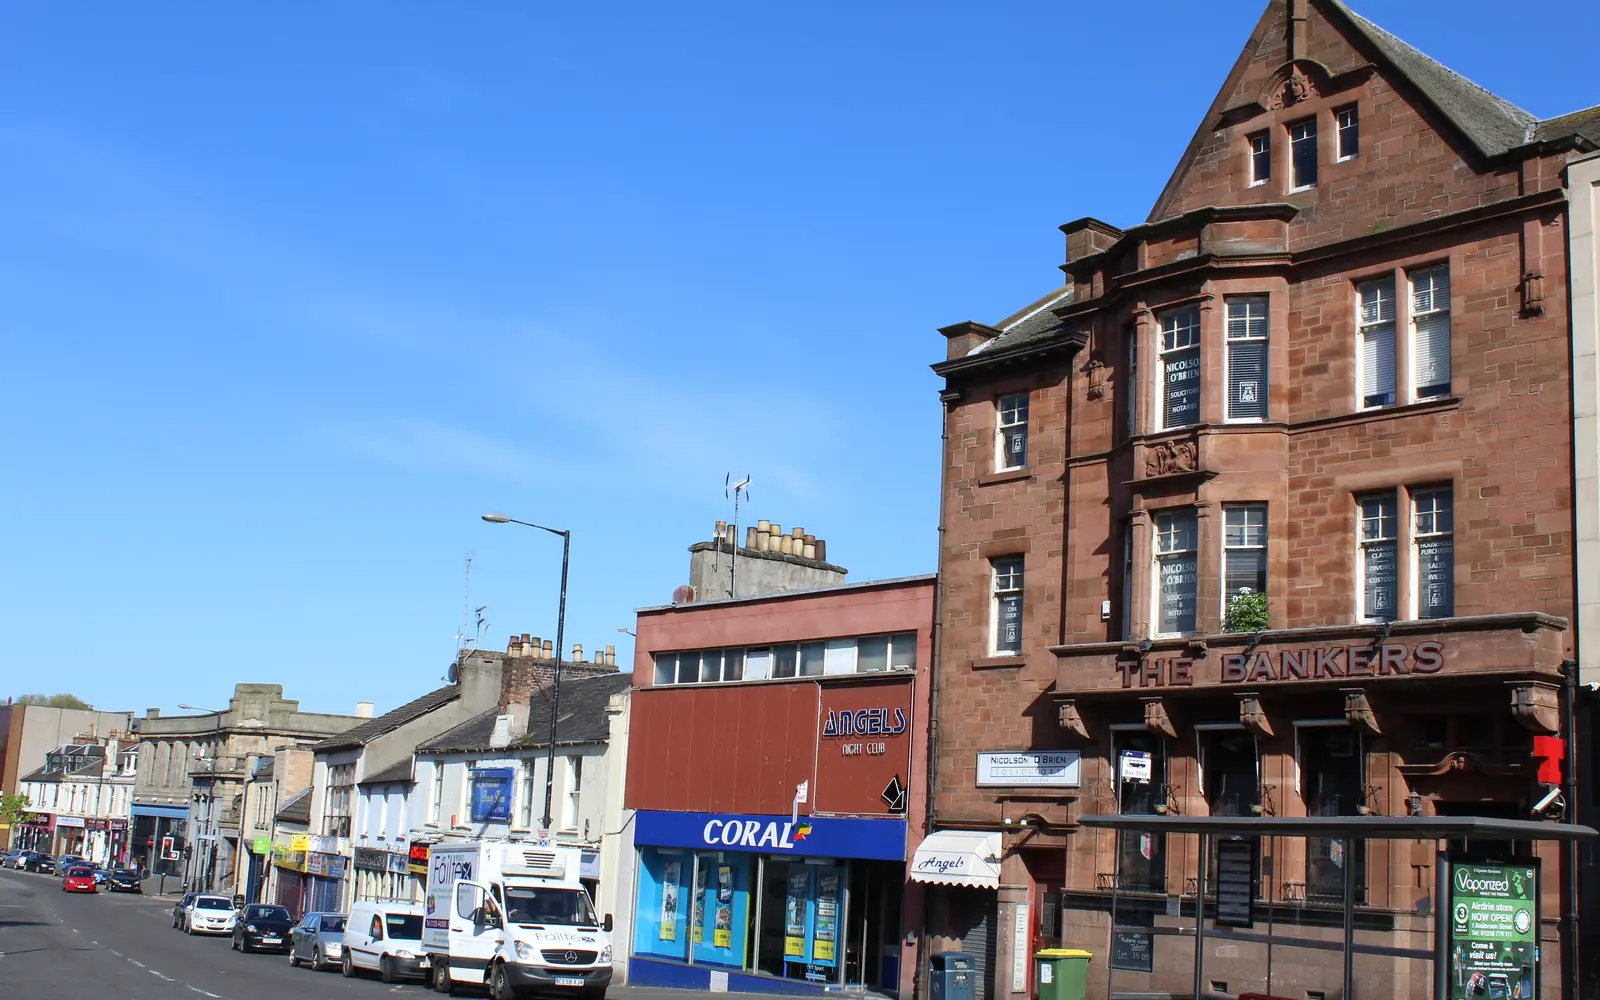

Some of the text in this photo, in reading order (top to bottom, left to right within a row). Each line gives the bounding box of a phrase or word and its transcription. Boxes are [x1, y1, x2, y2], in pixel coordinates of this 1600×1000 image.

[1166, 358, 1200, 372] NICOLSO
[1170, 368, 1200, 382] O'BRIEN
[1170, 388, 1199, 398] SOLICITORS
[1172, 403, 1197, 413] NOTARIES
[1420, 547, 1452, 555] PURCHASES
[1162, 562, 1196, 574] NICOLSO
[1166, 573, 1196, 585] O'BRIEN
[1166, 593, 1196, 601] SOLICITORS
[1168, 608, 1194, 616] NOTARIES
[1115, 639, 1445, 689] THE BANKERS
[823, 707, 907, 737] ANGELS
[842, 742, 886, 755] NIGHT CLUB
[990, 754, 1066, 764] NICOLSON O'BRIEN
[995, 768, 1061, 776] SOLICITORS
[703, 819, 794, 849] CORAL
[1457, 871, 1509, 892] Vaporized
[1471, 901, 1513, 912] Airdrie store
[1471, 912, 1513, 922] NOW OPEN!
[1471, 941, 1488, 949] Come
[1469, 950, 1497, 959] visit us!
